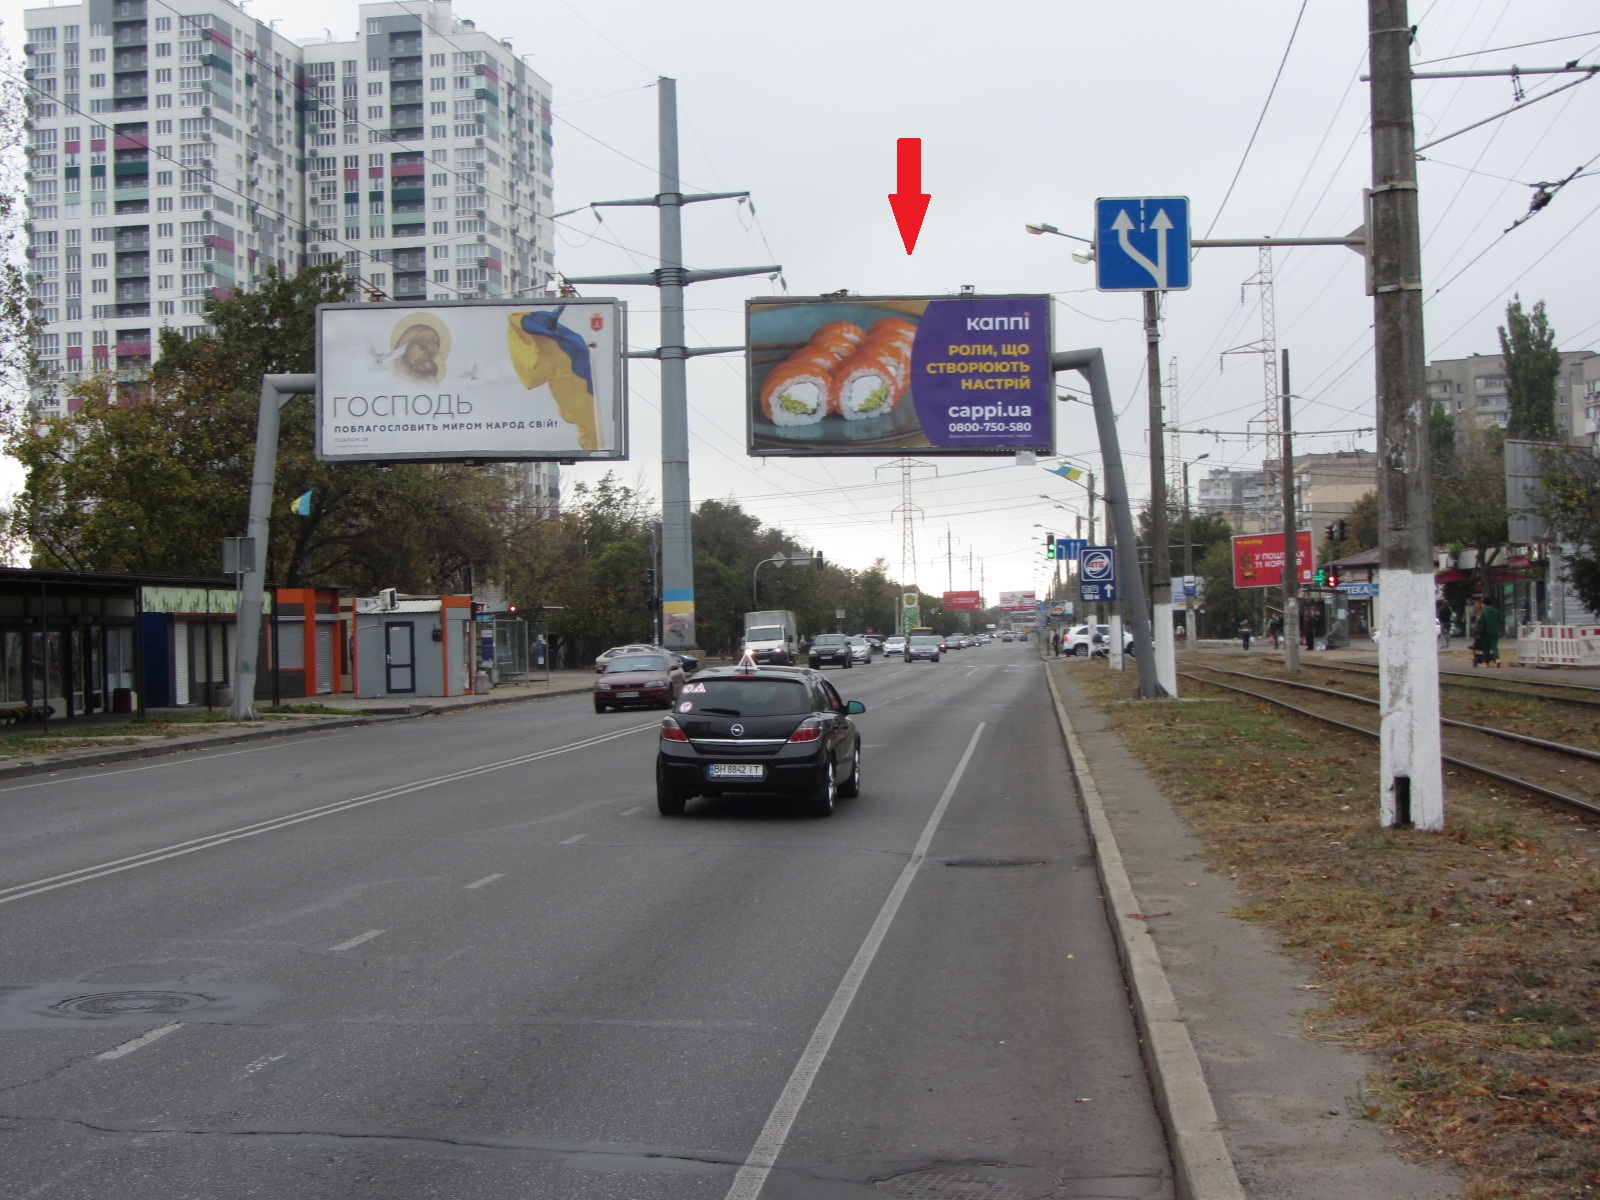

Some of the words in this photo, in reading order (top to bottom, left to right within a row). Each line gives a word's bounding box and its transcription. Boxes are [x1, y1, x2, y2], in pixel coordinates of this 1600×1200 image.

[966, 311, 1030, 331] каппі
[948, 344, 998, 357] РОЛИ,
[1001, 344, 1030, 357] ЩО
[926, 361, 1031, 374] СТВОРЮЮТЬ
[961, 375, 1031, 390] НАСТРІЙ
[333, 394, 473, 419] ГОСПОДЬ
[948, 401, 1032, 420] cappi.ua
[334, 423, 439, 433] ПОБЛАГОСЛОВИТЬ
[442, 422, 482, 431] МИРОМ
[486, 421, 526, 430] НАРОД
[528, 419, 558, 428] СВІЙ!
[948, 422, 1032, 432] 0800-750-580
[1254, 553, 1261, 561] У
[1262, 551, 1305, 561] ПОШХ
[1265, 558, 1302, 568] КОРВ
